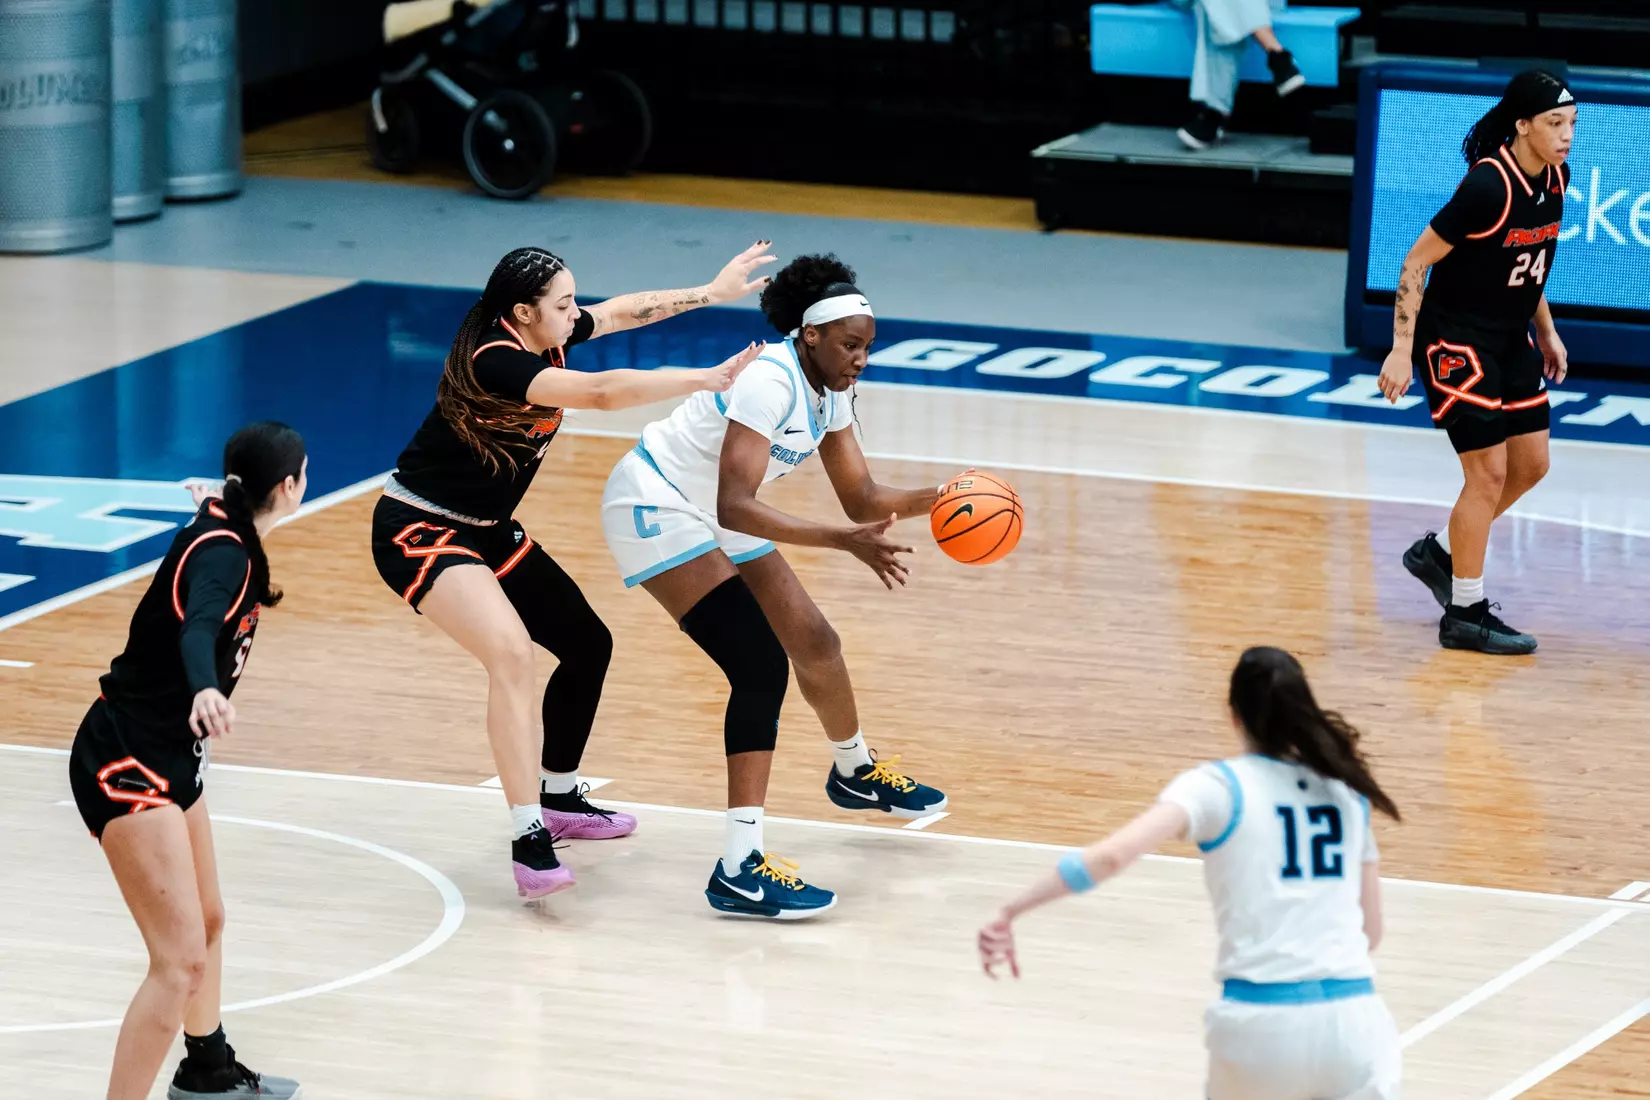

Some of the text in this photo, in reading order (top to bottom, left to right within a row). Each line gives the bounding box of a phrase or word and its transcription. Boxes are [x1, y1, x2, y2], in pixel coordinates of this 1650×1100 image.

[1507, 248, 1547, 287] 24
[769, 443, 816, 467] COLU
[632, 504, 661, 539] C
[1275, 803, 1345, 880] 12
